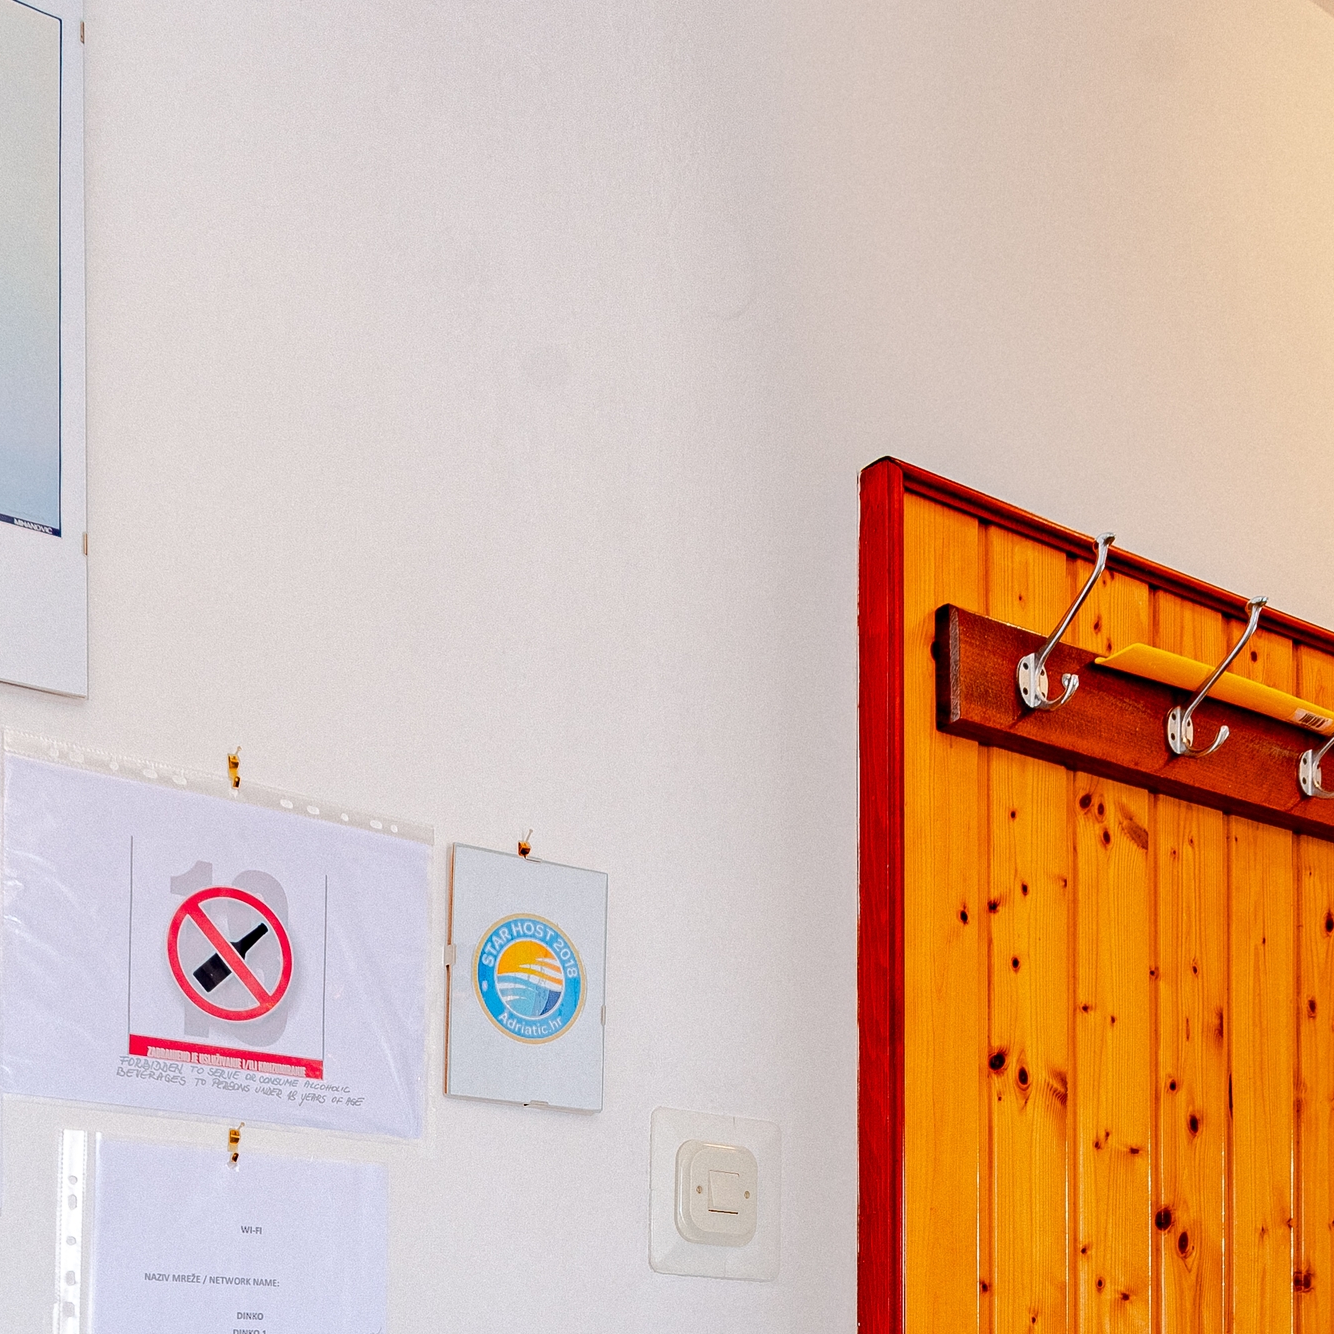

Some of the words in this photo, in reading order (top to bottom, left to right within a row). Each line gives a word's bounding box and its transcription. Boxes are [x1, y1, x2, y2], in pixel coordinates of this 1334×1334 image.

[481, 926, 512, 968] STAR
[510, 922, 555, 941] HOST
[553, 938, 579, 979] 2018
[498, 1012, 563, 1036] Adriatic.hr
[116, 1066, 187, 1087] BEVERAGES
[194, 1077, 207, 1087] TO
[254, 1085, 283, 1099] UNDER
[298, 1093, 327, 1107] YEARS
[331, 1096, 344, 1104] OF
[119, 1055, 184, 1075] FORBIDDEN
[190, 1065, 205, 1075] TO
[207, 1067, 241, 1081] SERVE
[245, 1073, 257, 1082] OR
[258, 1076, 299, 1088] CONSUME
[304, 1080, 351, 1094] ALCOHOLIC
[240, 1225, 263, 1236] WI-FI
[143, 1272, 171, 1282] NAZIV
[172, 1272, 201, 1284] MREŽE
[209, 1275, 251, 1287] NETWORK
[253, 1277, 281, 1288] NAME:
[236, 1311, 265, 1322] DINKO
